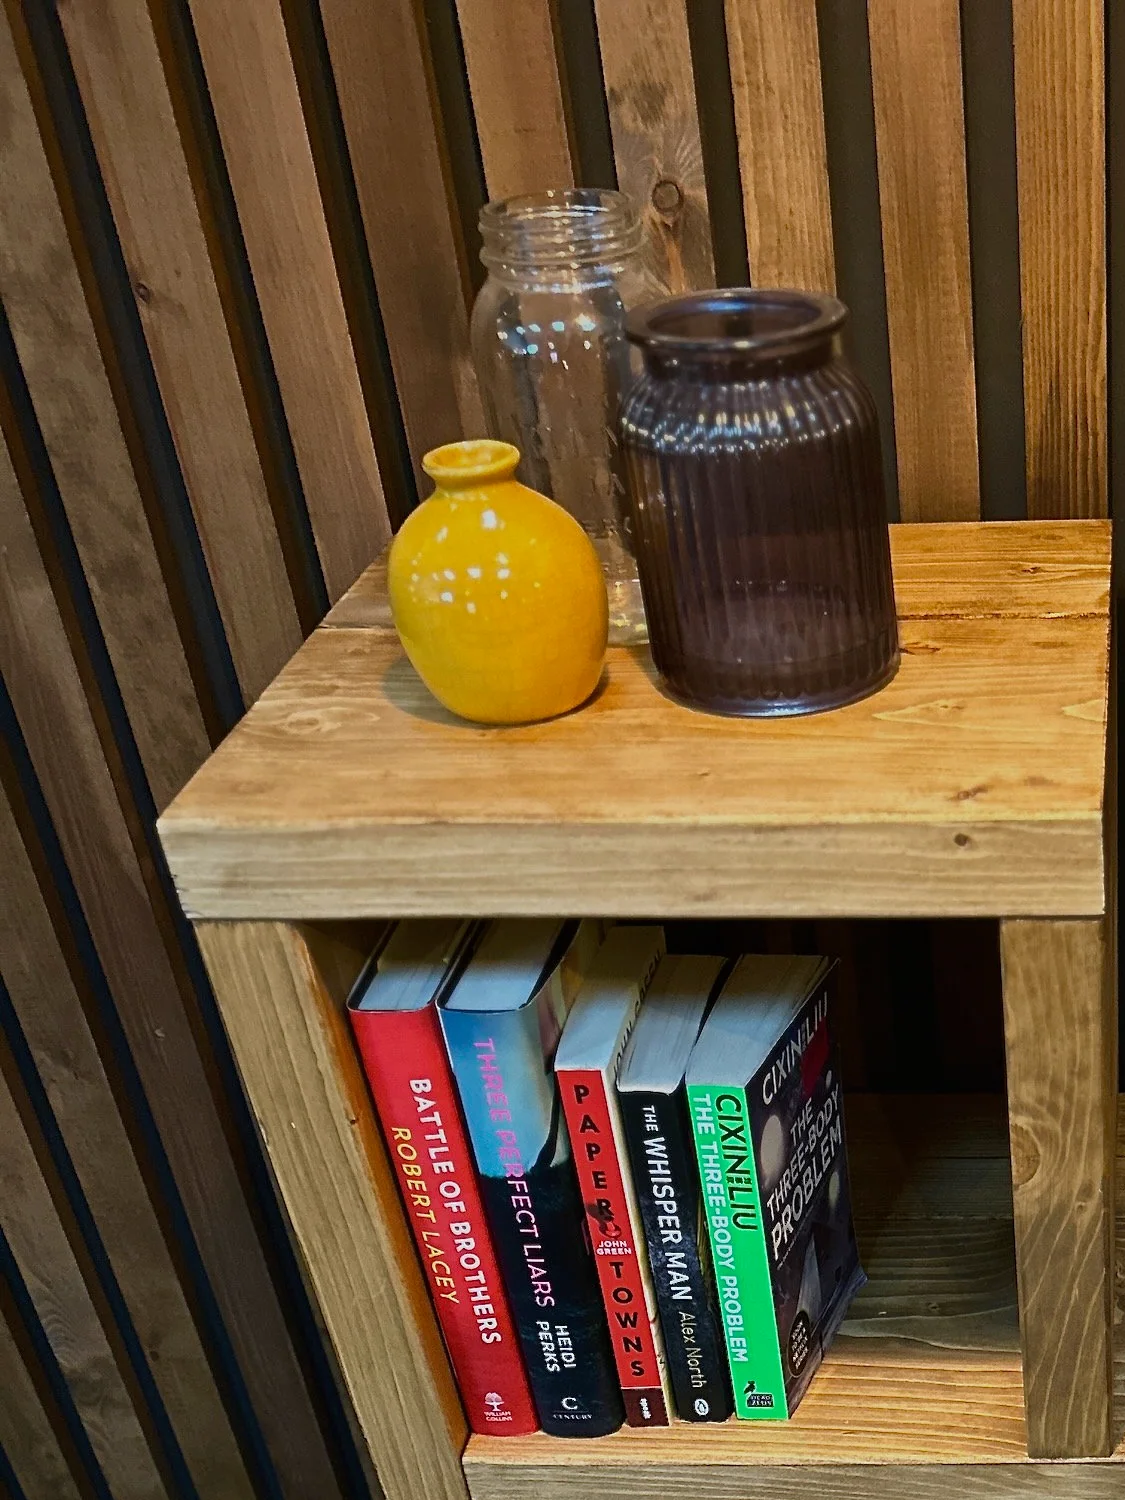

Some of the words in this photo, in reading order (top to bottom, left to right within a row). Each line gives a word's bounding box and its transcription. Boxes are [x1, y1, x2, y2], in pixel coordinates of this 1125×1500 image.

[762, 1028, 804, 1106] CIXIN
[409, 1078, 455, 1175] BATTLE
[642, 1104, 659, 1133] THE
[693, 1093, 716, 1136] THE
[715, 1093, 751, 1175] CIXIN
[790, 1097, 813, 1147] THE
[474, 1038, 512, 1123] THREE
[496, 1130, 539, 1238] PERFECT
[523, 1244, 555, 1307] LIARS
[766, 1083, 839, 1222] THREE-BODY
[391, 1127, 437, 1224] ROBERT
[421, 1230, 460, 1305] LACEY
[439, 1181, 467, 1214] OF
[643, 1136, 683, 1245] WHISPER
[700, 1140, 736, 1270] THREE-BODY
[727, 1186, 759, 1231] LIU
[770, 1114, 842, 1261] PROBLEM
[596, 1247, 632, 1256] GREEN
[598, 1240, 627, 1248] JOHN
[664, 1251, 693, 1301] MAN
[450, 1220, 502, 1344] BROTHERS
[536, 1320, 561, 1372] PERKS
[554, 1325, 577, 1368] HEIDI
[609, 1261, 645, 1377] TOWNS
[678, 1311, 698, 1344] Alex
[720, 1275, 749, 1363] PROBLEM
[684, 1348, 708, 1388] North
